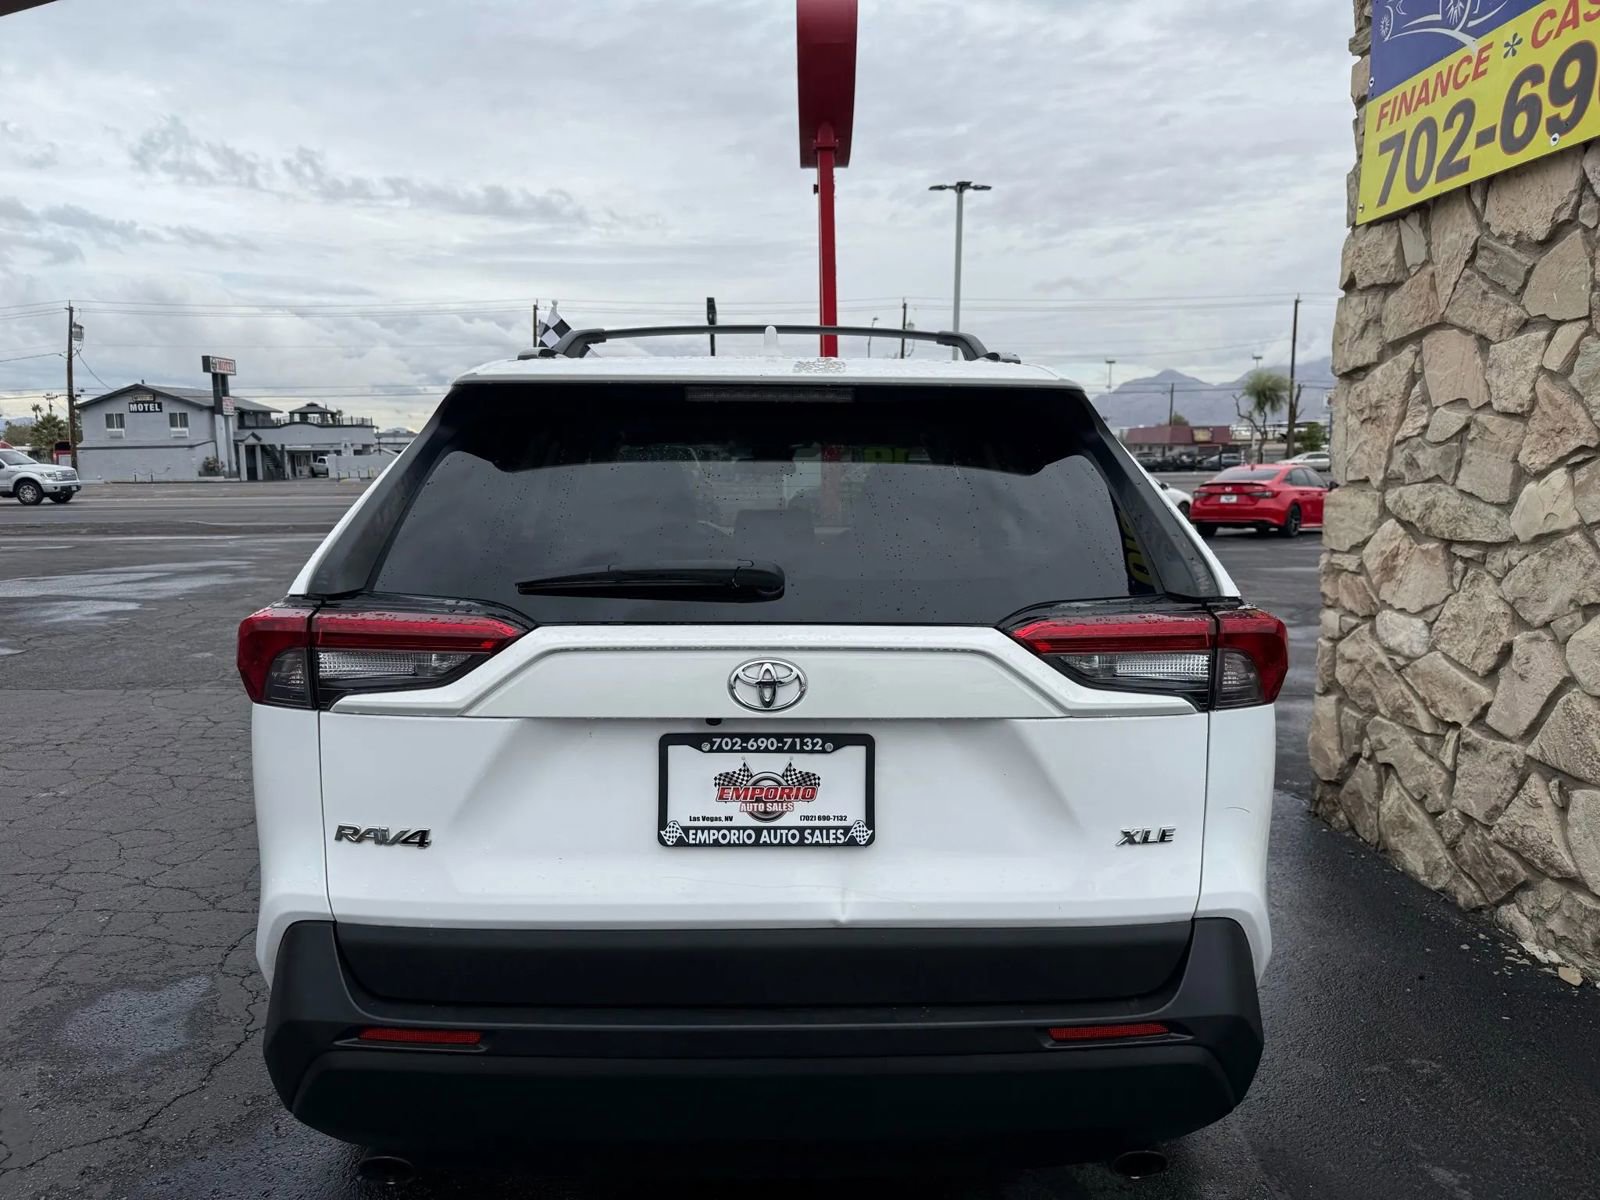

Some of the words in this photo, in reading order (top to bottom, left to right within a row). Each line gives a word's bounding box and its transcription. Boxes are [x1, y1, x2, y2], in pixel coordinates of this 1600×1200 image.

[1376, 41, 1494, 133] FINANCE
[1376, 40, 1600, 209] 702-69
[129, 403, 161, 412] MOTEL
[712, 737, 823, 751] 702-690-7132
[717, 785, 817, 802] EMPORIO
[740, 802, 765, 812] AUTO
[766, 802, 794, 812] SALES
[701, 815, 723, 823] Vegas,
[334, 823, 432, 849] RAV4
[688, 829, 759, 844] EMPORIO
[759, 829, 800, 844] AUTO
[804, 829, 845, 844] SALES
[1115, 826, 1176, 847] XLE
